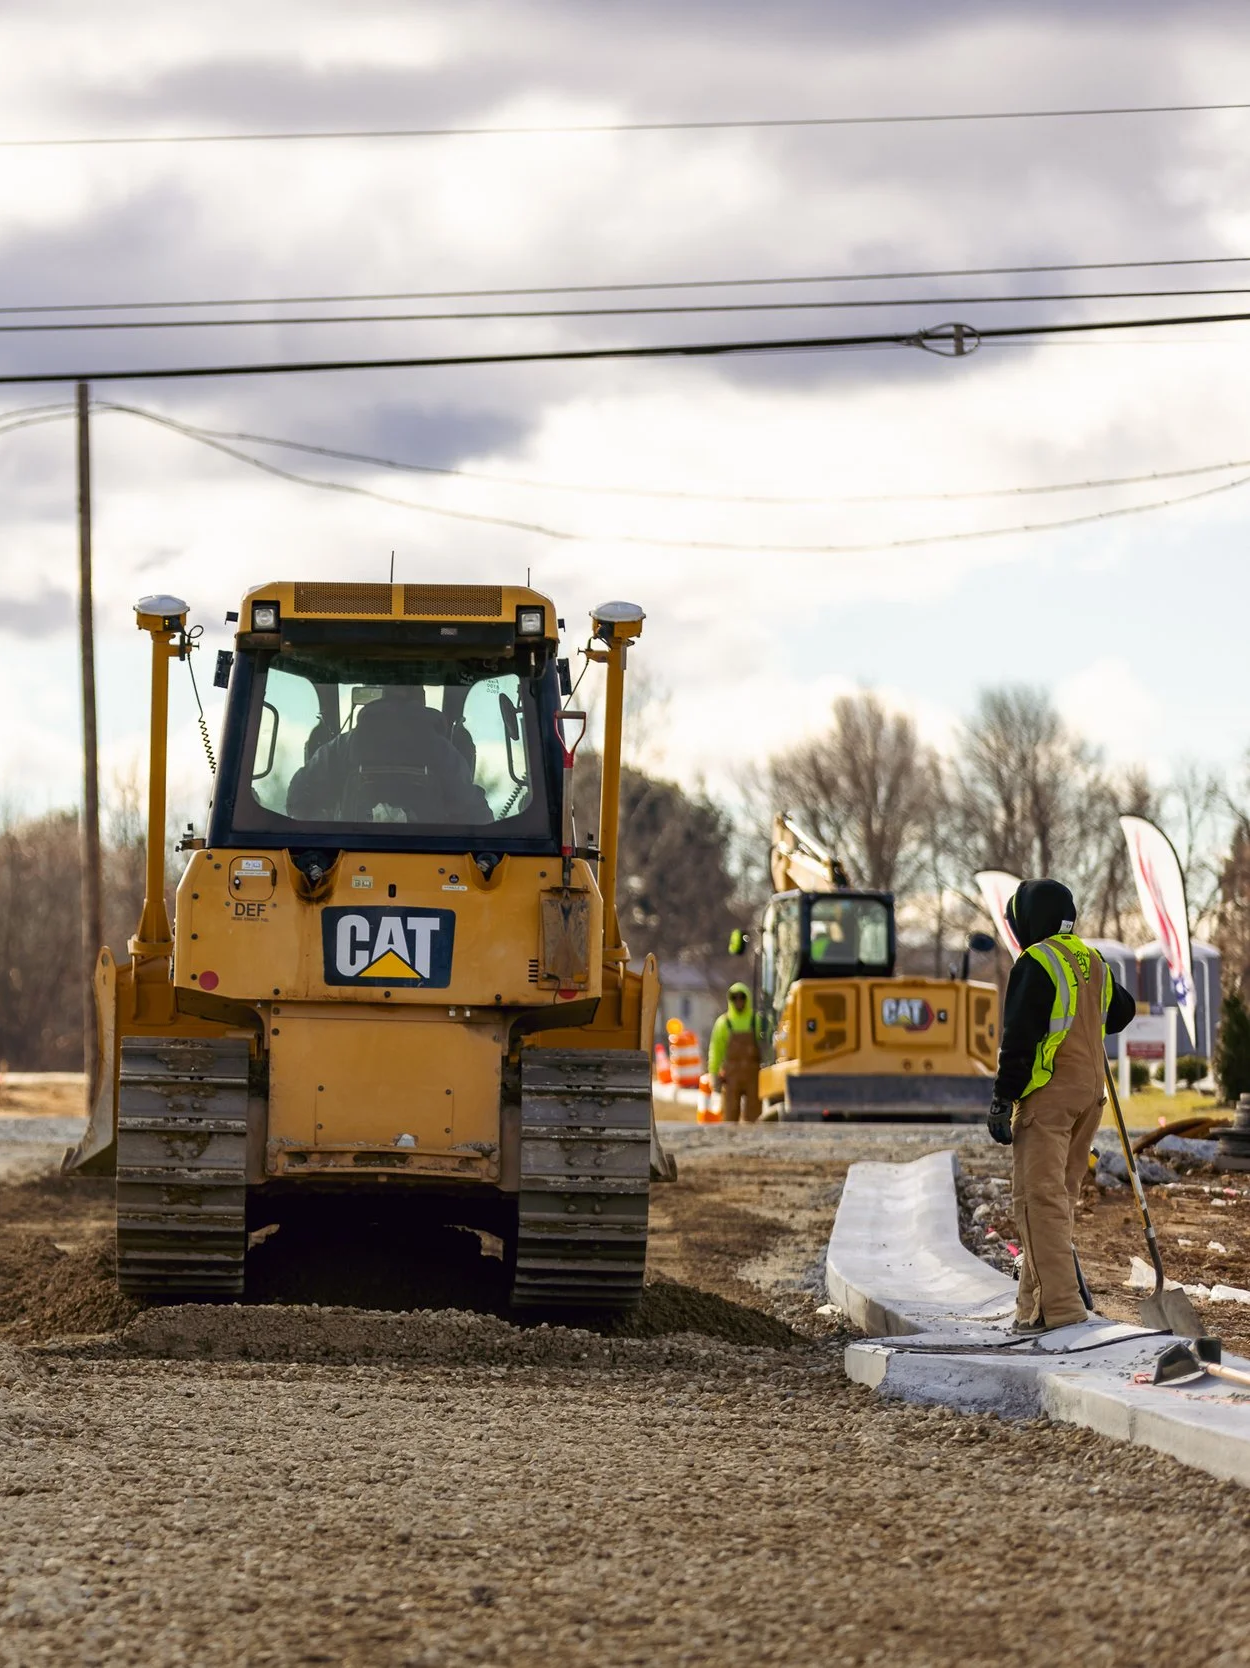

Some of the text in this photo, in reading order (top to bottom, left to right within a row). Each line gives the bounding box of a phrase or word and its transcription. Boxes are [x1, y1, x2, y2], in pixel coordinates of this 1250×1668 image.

[235, 903, 266, 917] DEF
[336, 915, 440, 979] CAT
[882, 998, 923, 1026] CAT
